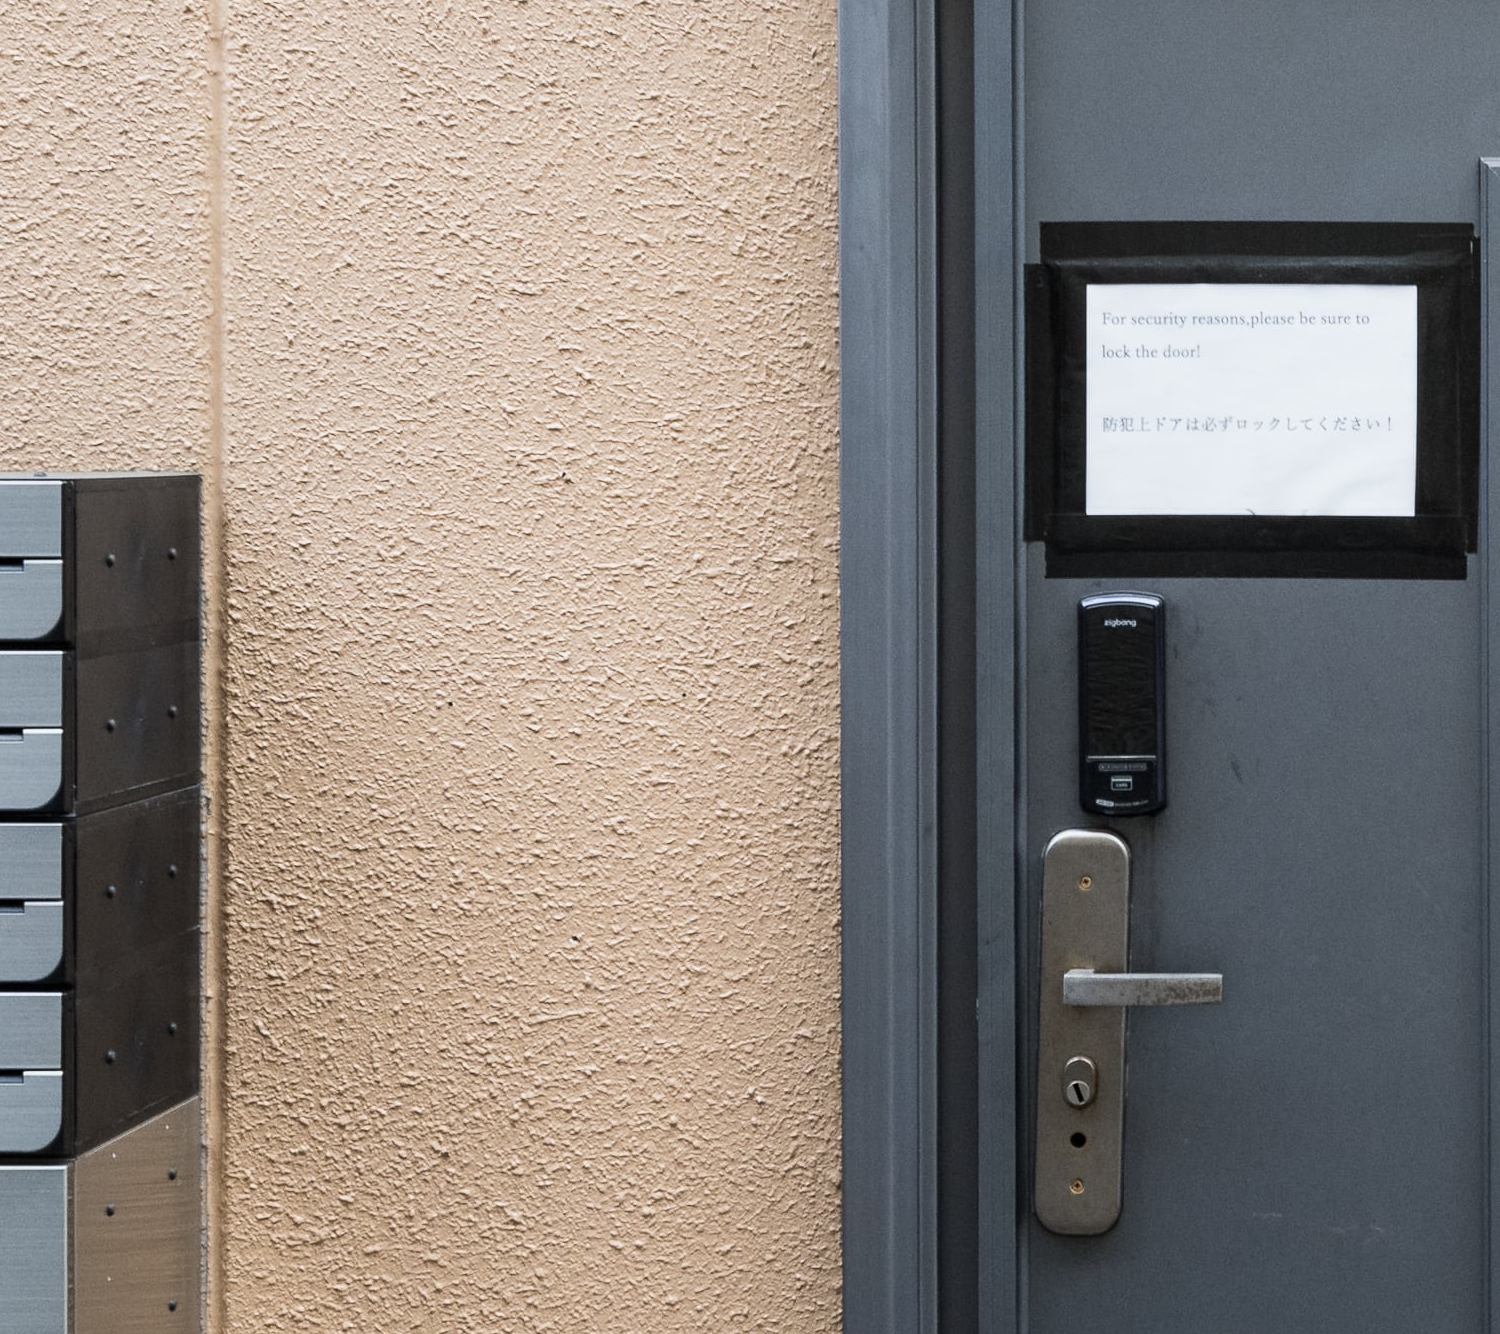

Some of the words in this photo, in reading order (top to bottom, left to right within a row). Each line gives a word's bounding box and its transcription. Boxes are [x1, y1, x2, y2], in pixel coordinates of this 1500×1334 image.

[1102, 312, 1127, 326] For
[1131, 311, 1187, 329] security
[1299, 311, 1316, 325] be
[1320, 315, 1351, 325] sure
[1356, 314, 1370, 325] to
[1102, 344, 1131, 359] lock
[1135, 344, 1158, 359] the
[1163, 344, 1201, 359] door!
[1104, 618, 1137, 628] zigbang
